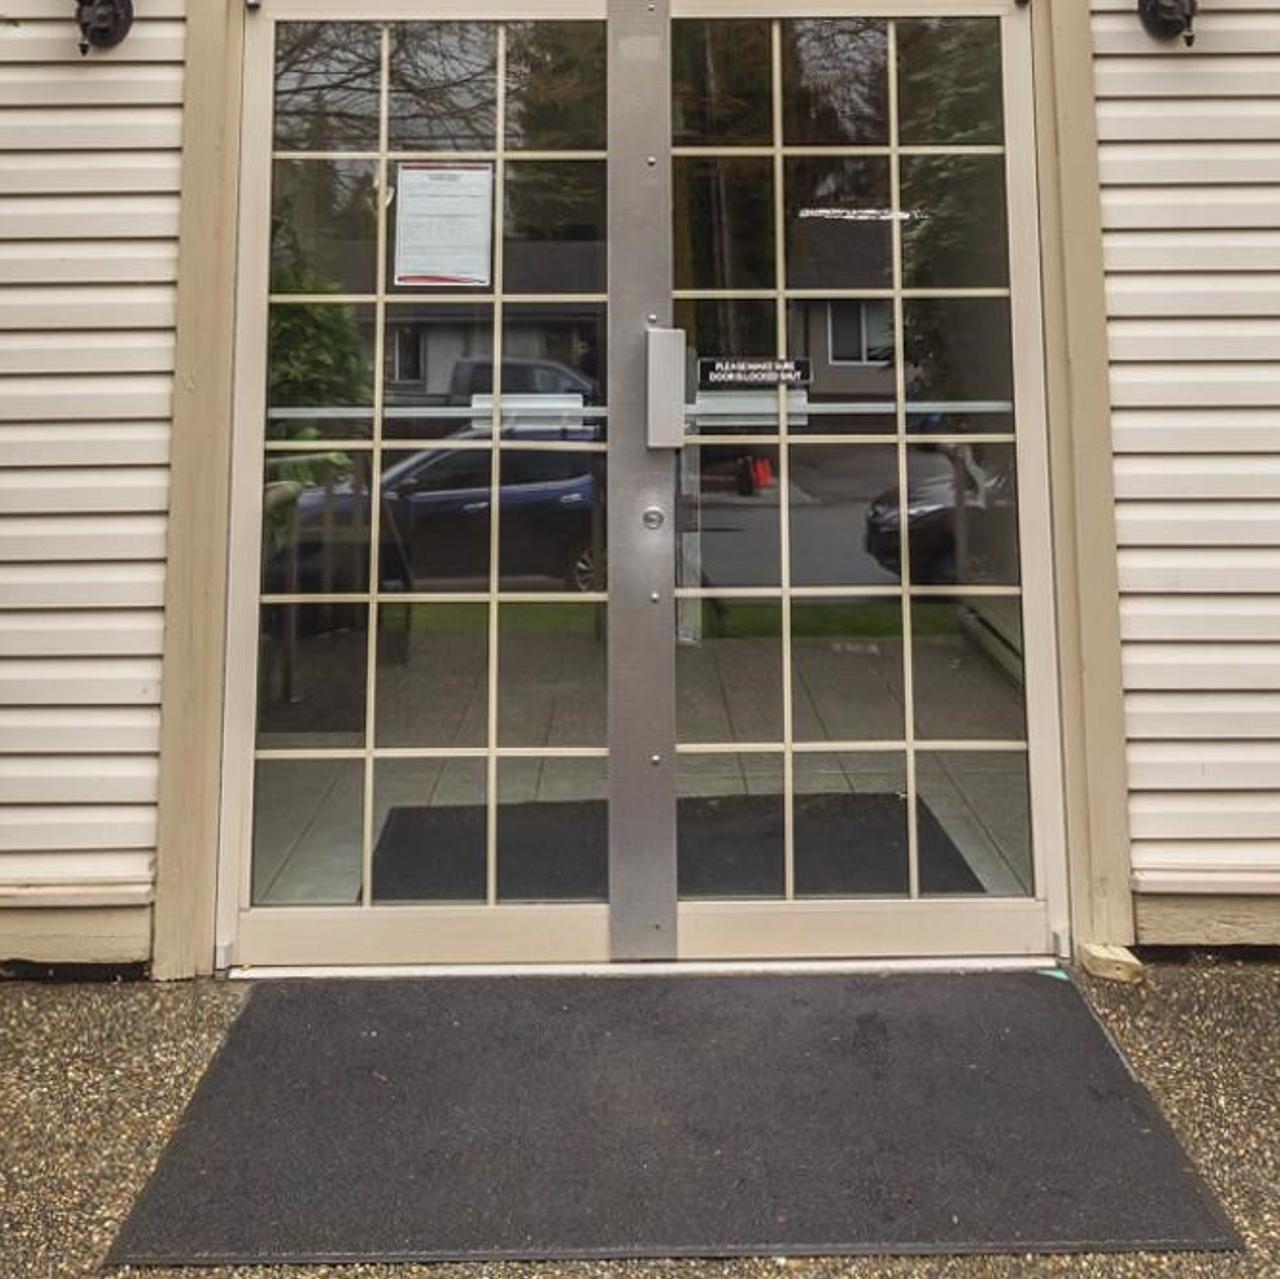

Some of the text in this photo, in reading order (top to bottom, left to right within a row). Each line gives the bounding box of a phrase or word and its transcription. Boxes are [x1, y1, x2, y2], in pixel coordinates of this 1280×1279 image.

[715, 361, 745, 371] PLEASE
[709, 371, 733, 381] DOOR
[744, 371, 779, 381] LOCKED
